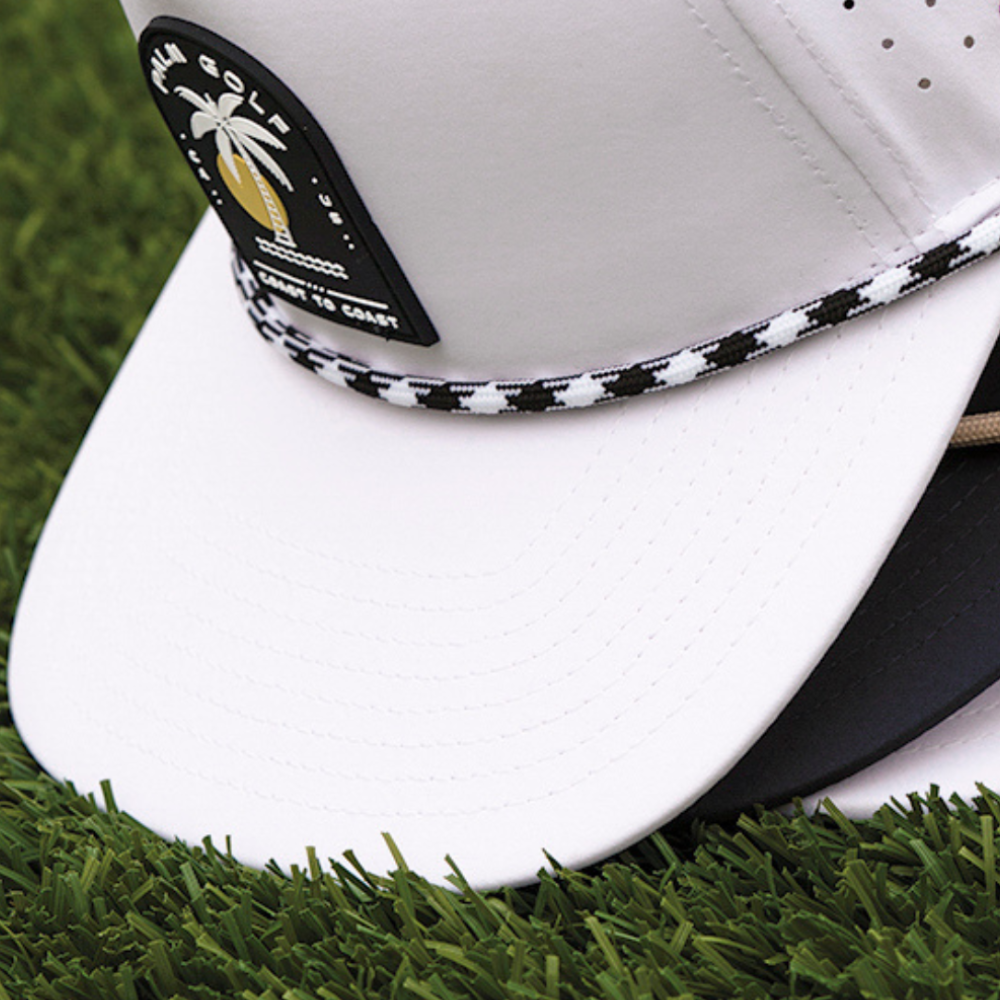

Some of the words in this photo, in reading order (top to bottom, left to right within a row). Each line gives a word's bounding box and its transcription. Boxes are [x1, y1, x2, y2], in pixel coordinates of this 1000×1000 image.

[198, 53, 291, 135] GOLF
[311, 293, 337, 312] TO
[341, 303, 399, 330] COAST
